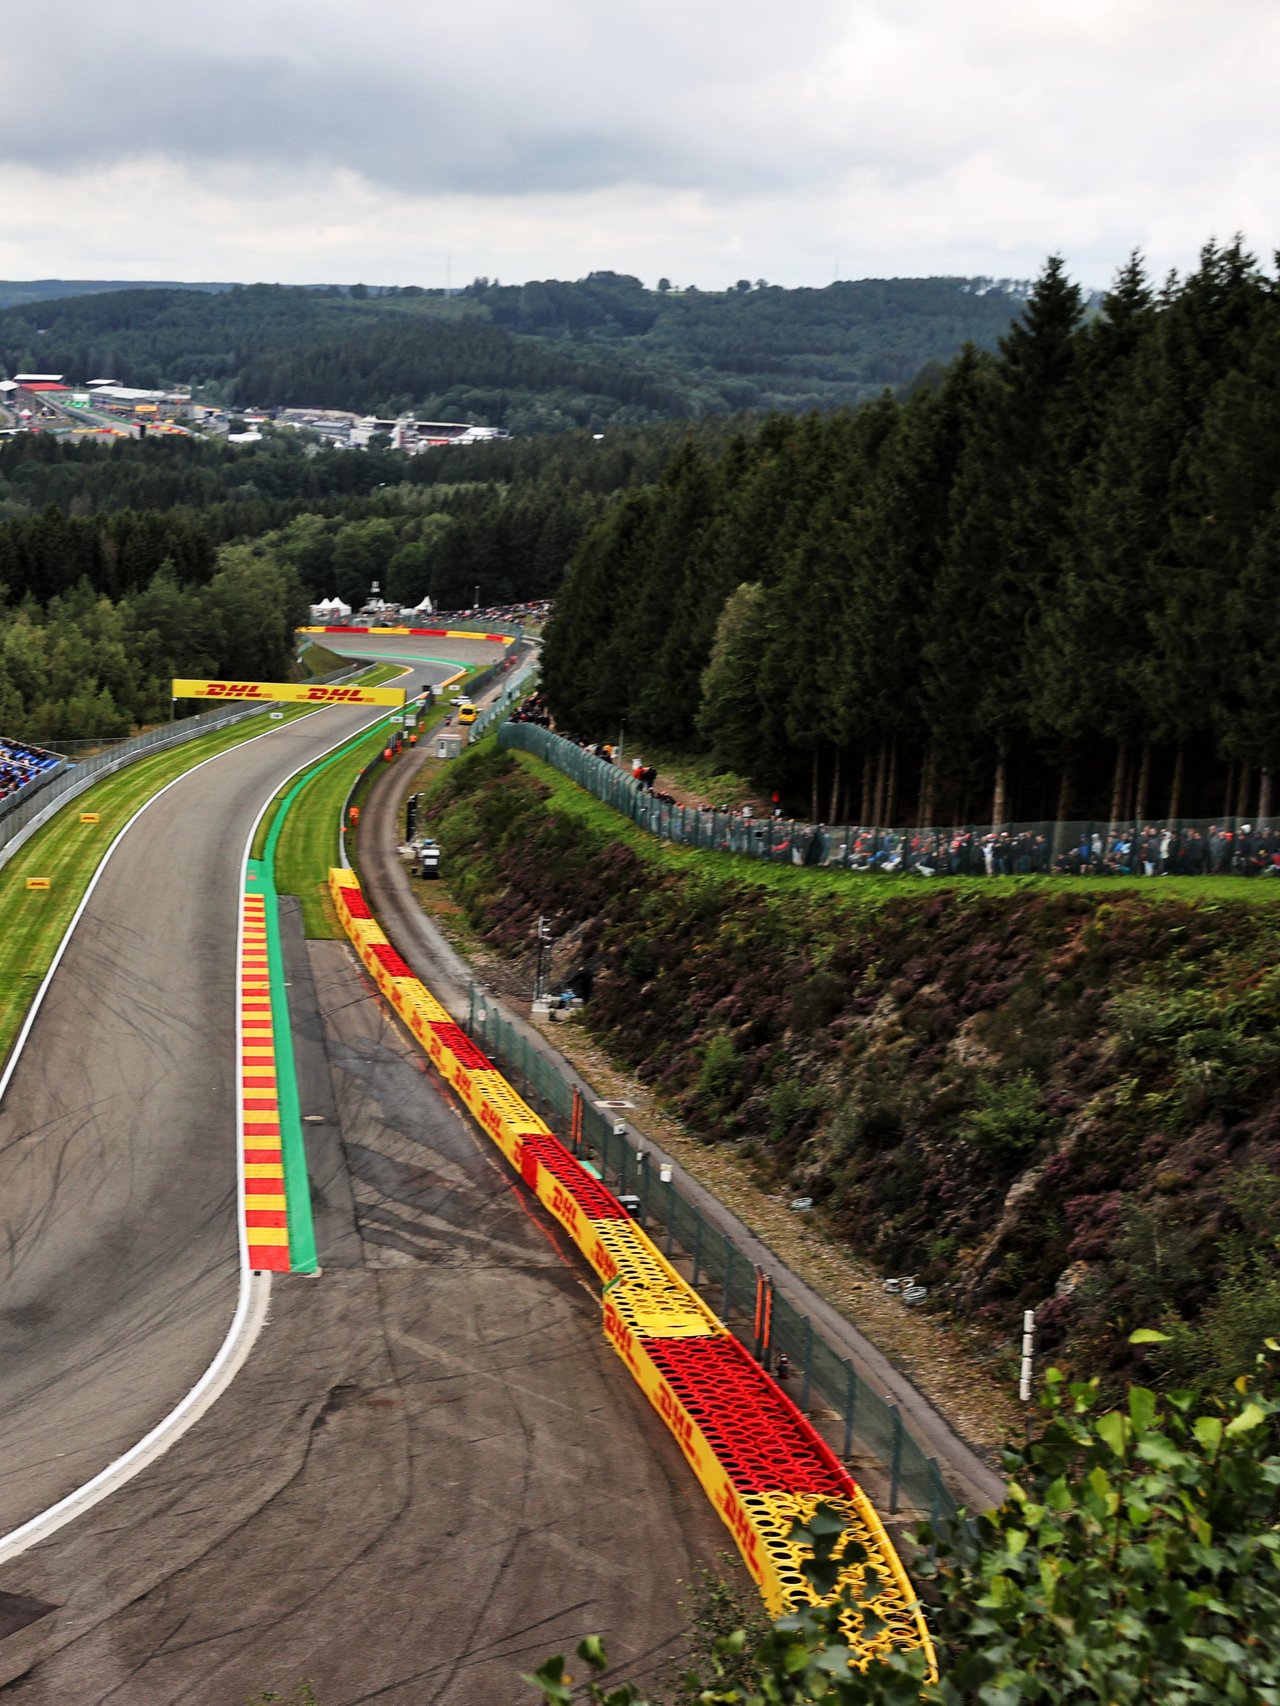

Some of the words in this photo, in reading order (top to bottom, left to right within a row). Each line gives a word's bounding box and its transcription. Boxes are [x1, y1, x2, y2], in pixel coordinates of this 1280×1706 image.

[206, 684, 262, 698] DHL
[306, 687, 364, 702] DHL
[479, 1100, 503, 1138] DHL
[552, 1185, 579, 1233] DHL
[605, 1302, 636, 1368] DHL
[659, 1381, 695, 1459] DHL
[724, 1480, 760, 1574] DHL
